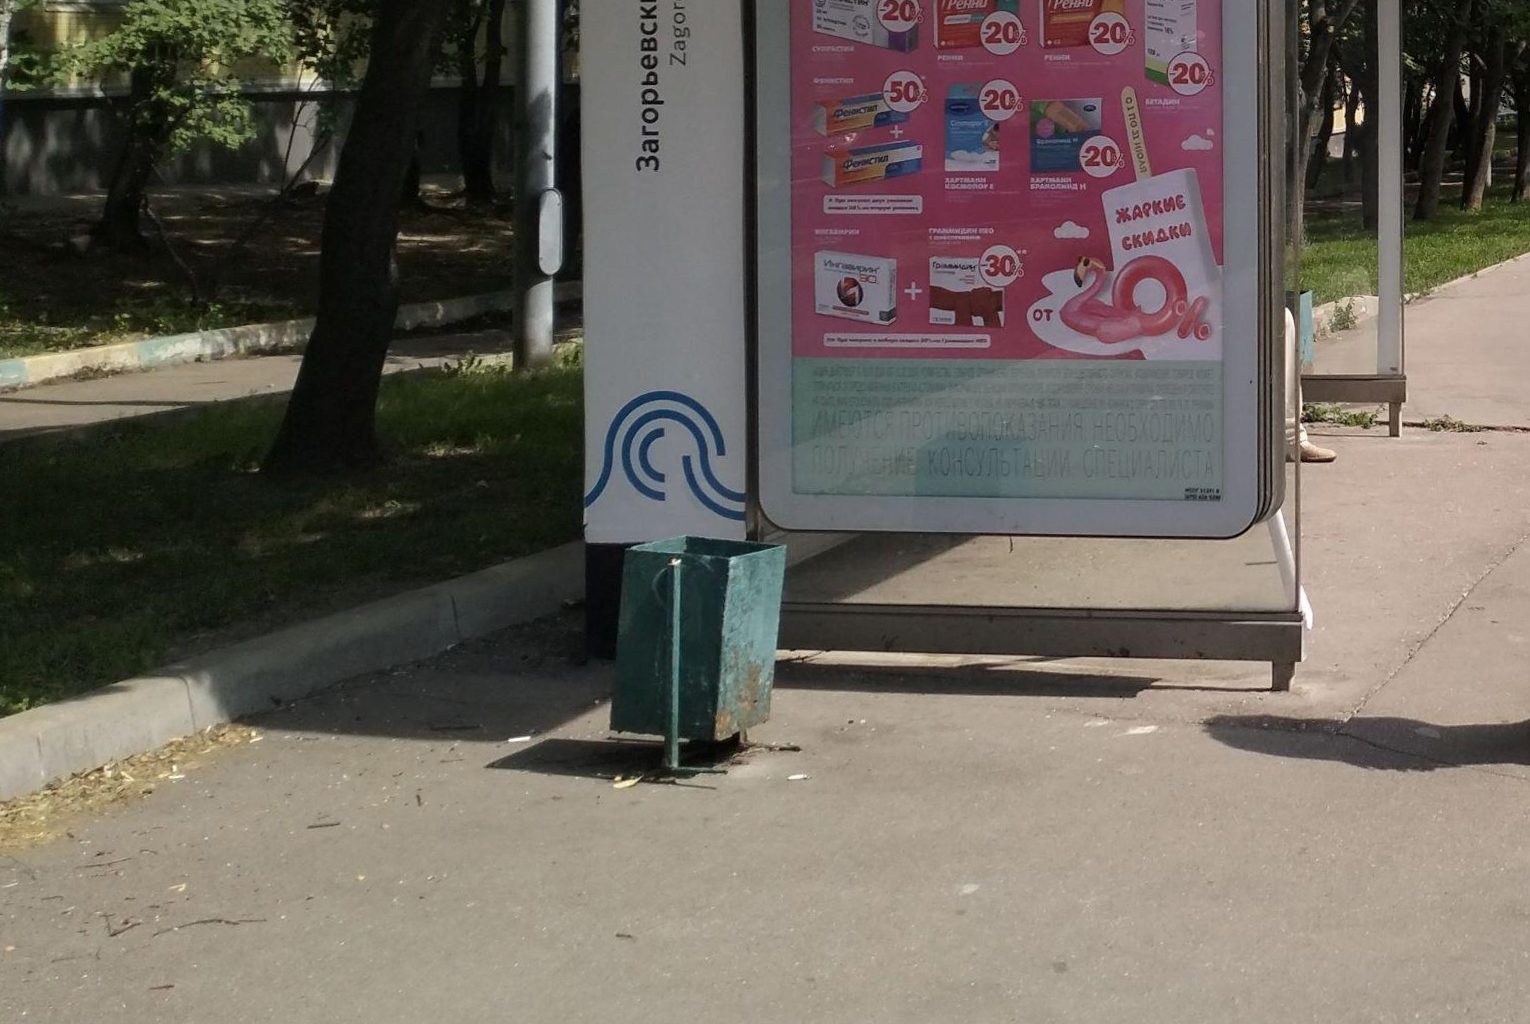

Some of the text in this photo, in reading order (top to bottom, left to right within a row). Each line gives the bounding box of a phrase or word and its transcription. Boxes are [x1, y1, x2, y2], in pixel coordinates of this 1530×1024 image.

[879, 0, 924, 23] -20%
[982, 21, 1028, 46] -20%
[1090, 22, 1136, 46] -20%
[1169, 62, 1215, 87] -20%
[981, 89, 1024, 112] -20%
[1081, 145, 1126, 169] -20%
[1115, 194, 1186, 224] ЖАРКИЕ
[1122, 222, 1192, 251] СКИДКИ
[1093, 412, 1214, 443] НЕОБХОДИМО
[928, 446, 1071, 478] КОНСУЛЬТАЦИИ
[1083, 448, 1214, 480] СПЕЦИАЛИСТА
